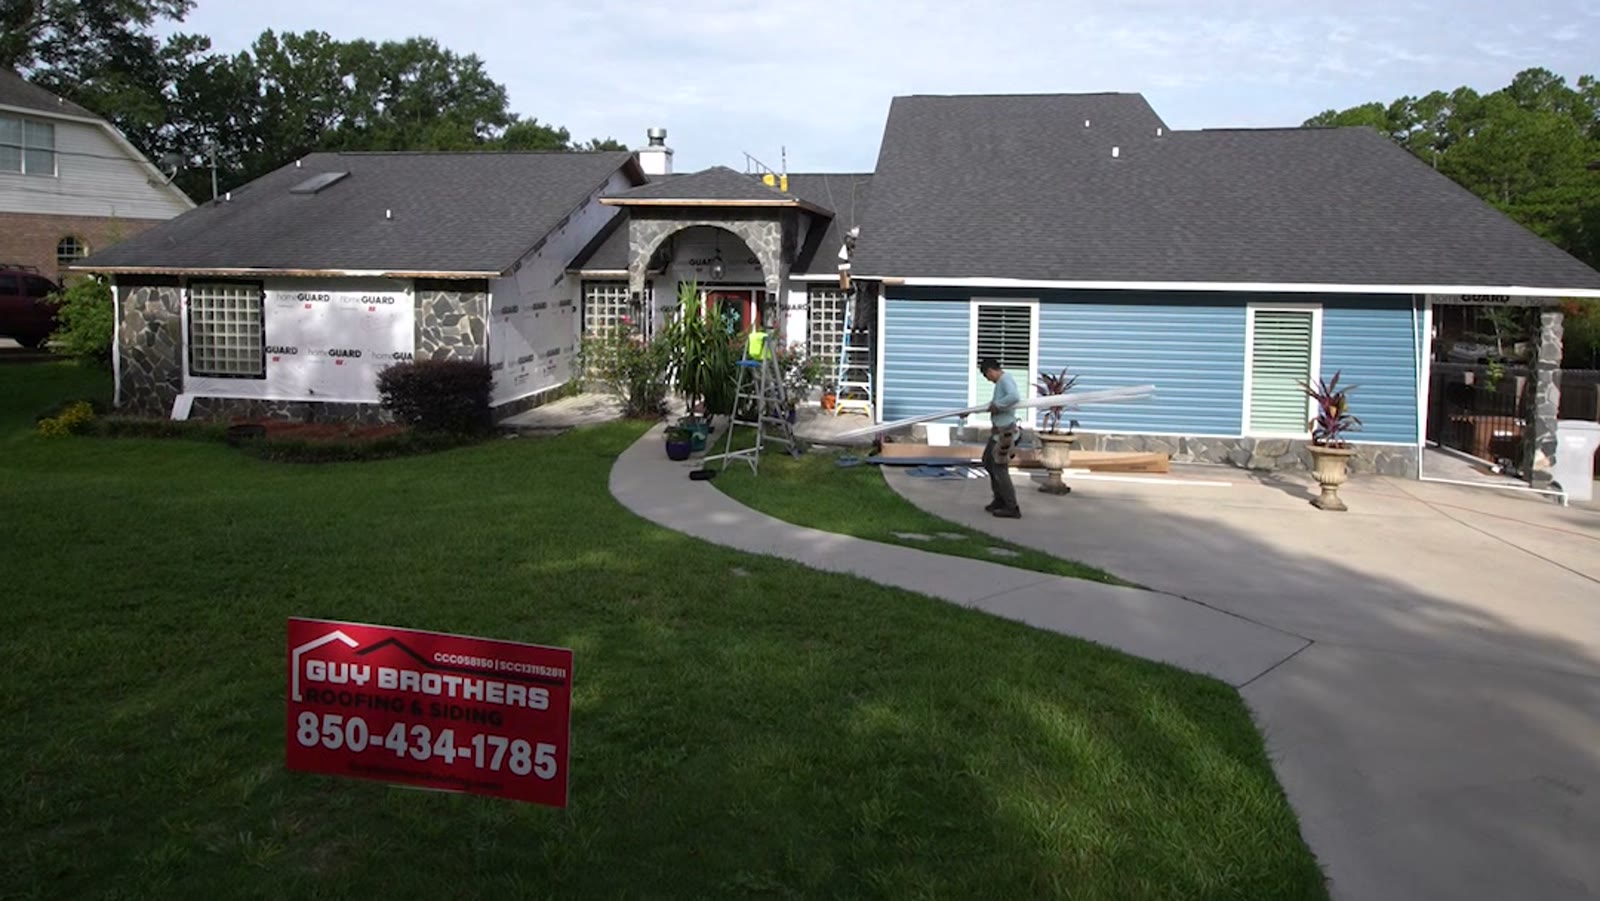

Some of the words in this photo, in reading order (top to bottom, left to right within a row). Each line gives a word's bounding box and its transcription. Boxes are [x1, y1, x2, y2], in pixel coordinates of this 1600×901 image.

[306, 659, 371, 686] GUY
[378, 667, 549, 710] BROTHERS
[306, 687, 404, 714] ROOFING
[411, 700, 423, 717] &
[430, 702, 503, 728] SIDING
[296, 711, 557, 780] 850-434-1785
